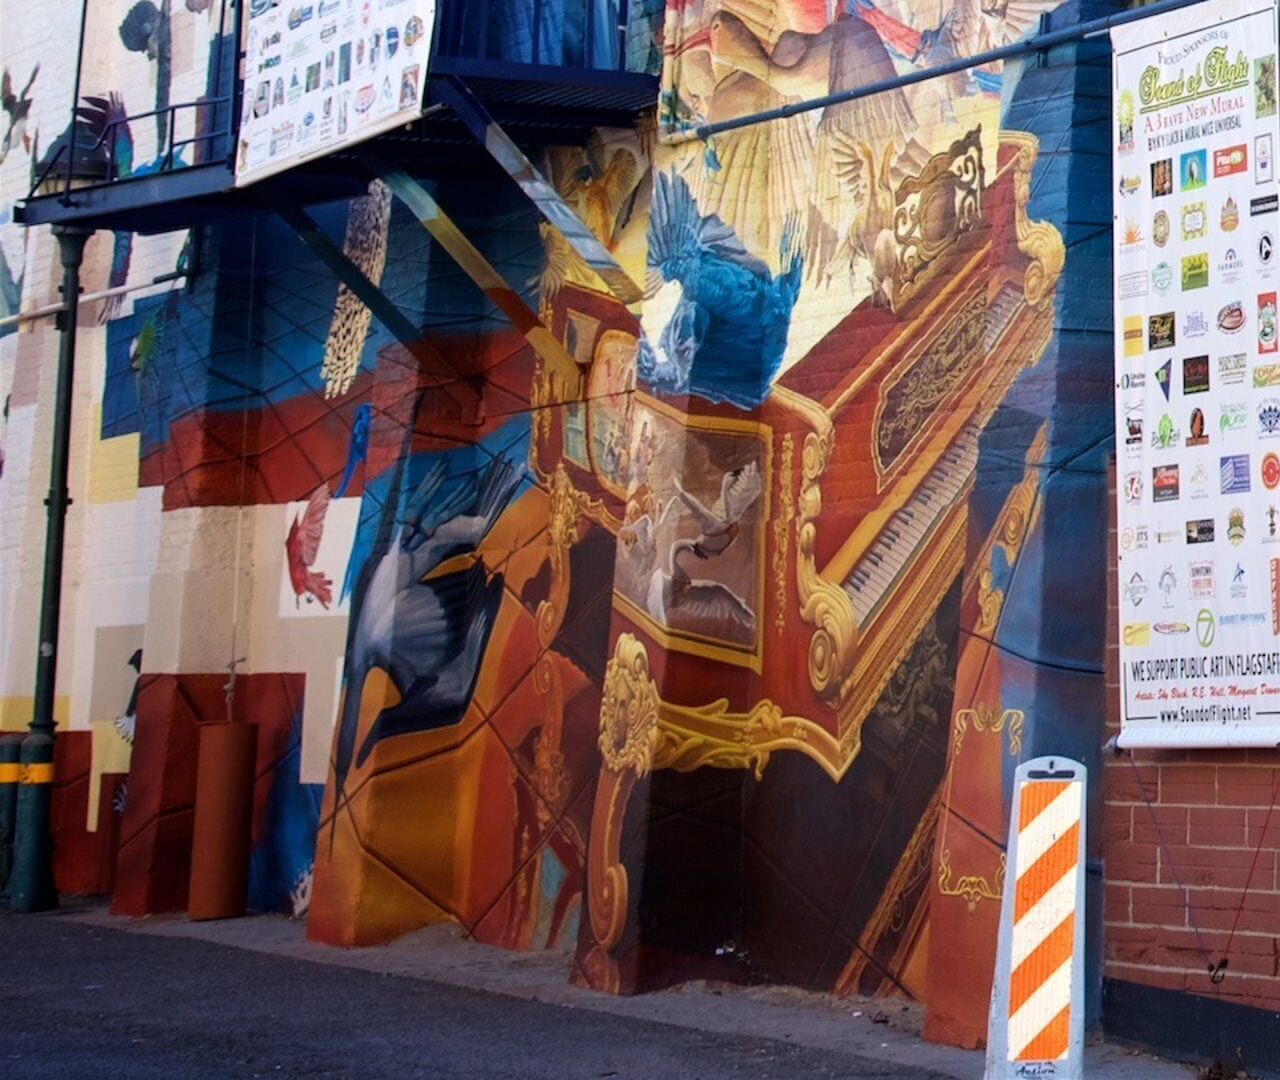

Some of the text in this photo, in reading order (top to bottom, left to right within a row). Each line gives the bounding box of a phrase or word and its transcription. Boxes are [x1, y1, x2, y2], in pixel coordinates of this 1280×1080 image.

[1203, 45, 1250, 92] Flight
[1186, 103, 1208, 123] NEW
[1210, 95, 1246, 117] MURAL
[1131, 652, 1280, 682] WE SUPPORT PUBLIC ART IN FLAGSTAFF
[1159, 704, 1252, 726] www.SoundofFlight.net
